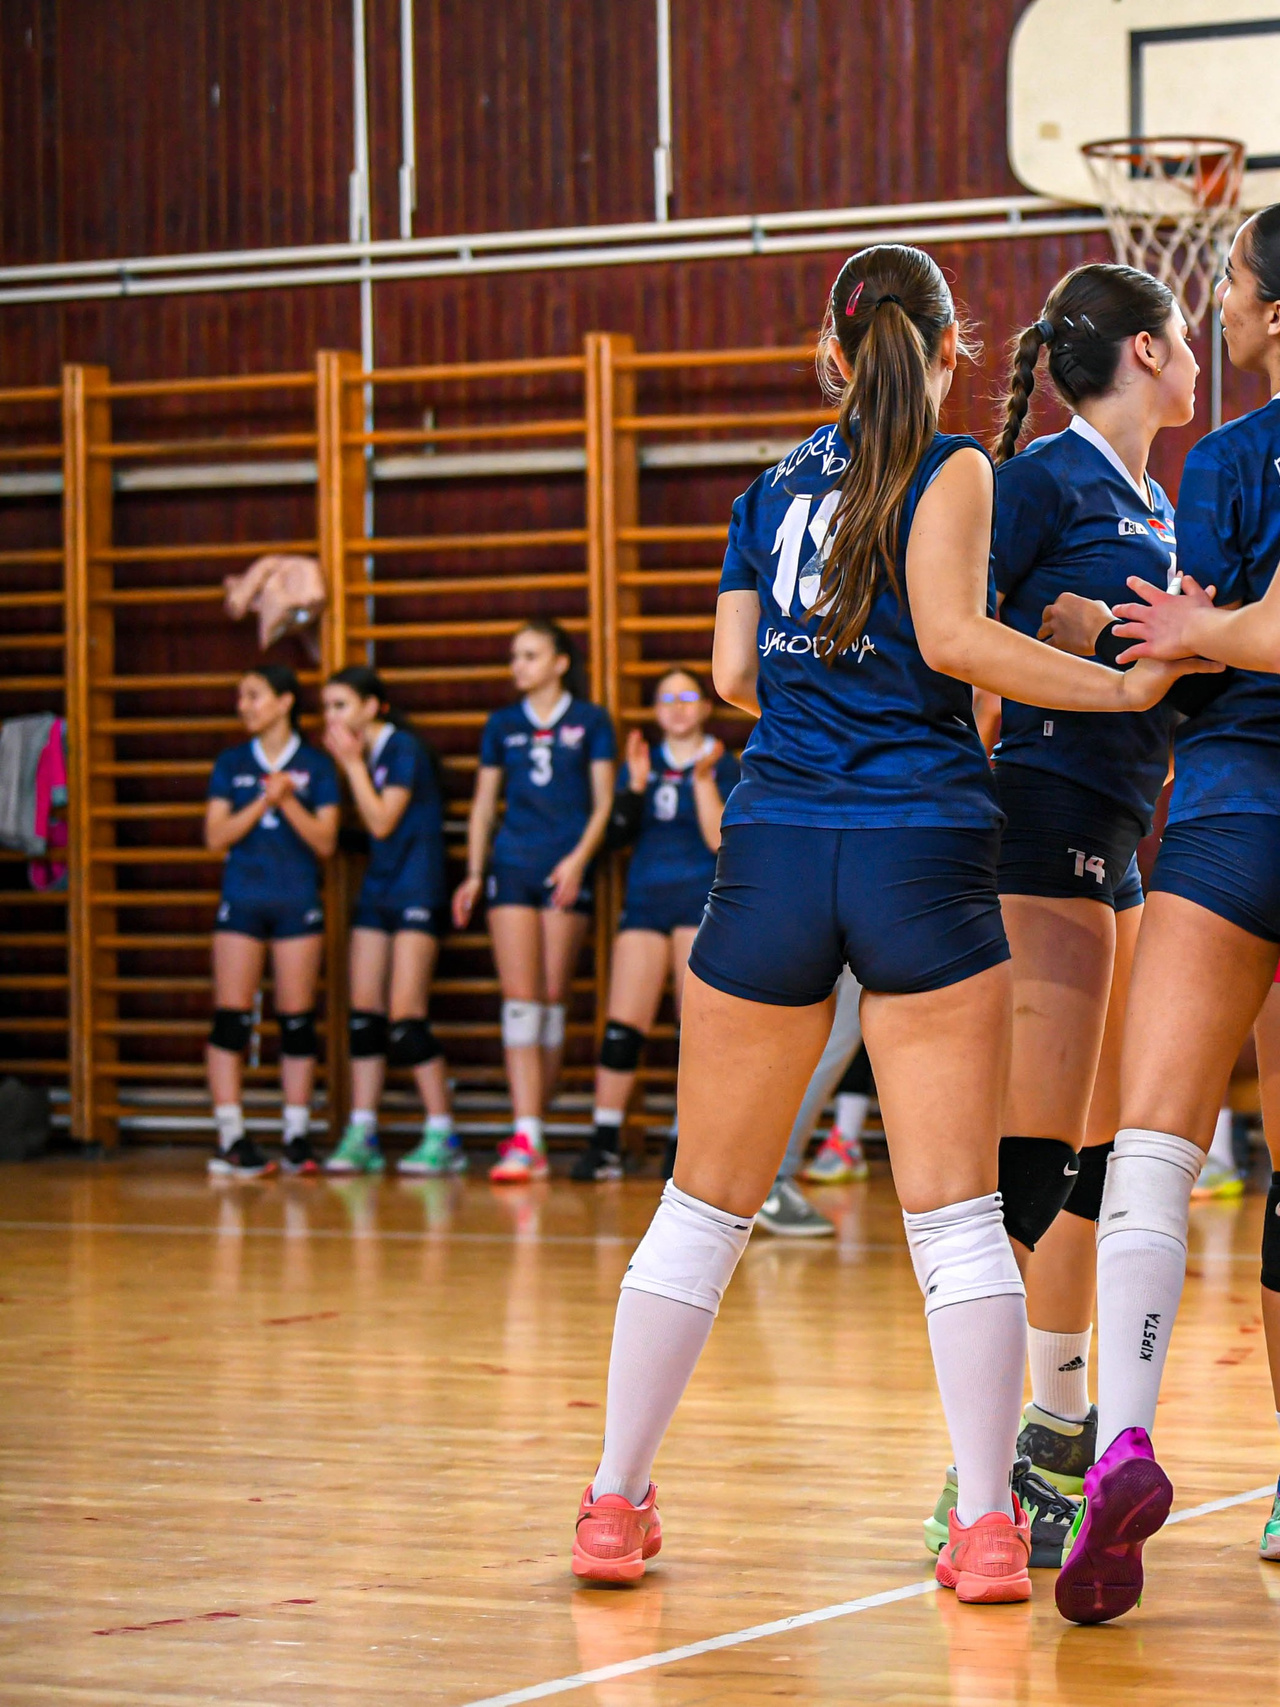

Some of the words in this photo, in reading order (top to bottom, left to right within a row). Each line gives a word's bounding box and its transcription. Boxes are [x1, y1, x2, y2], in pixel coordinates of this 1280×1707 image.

[770, 423, 839, 488] BLOCK
[528, 746, 553, 787] 3
[1066, 847, 1106, 885] 14
[1139, 1313, 1161, 1362] KIPSTA
